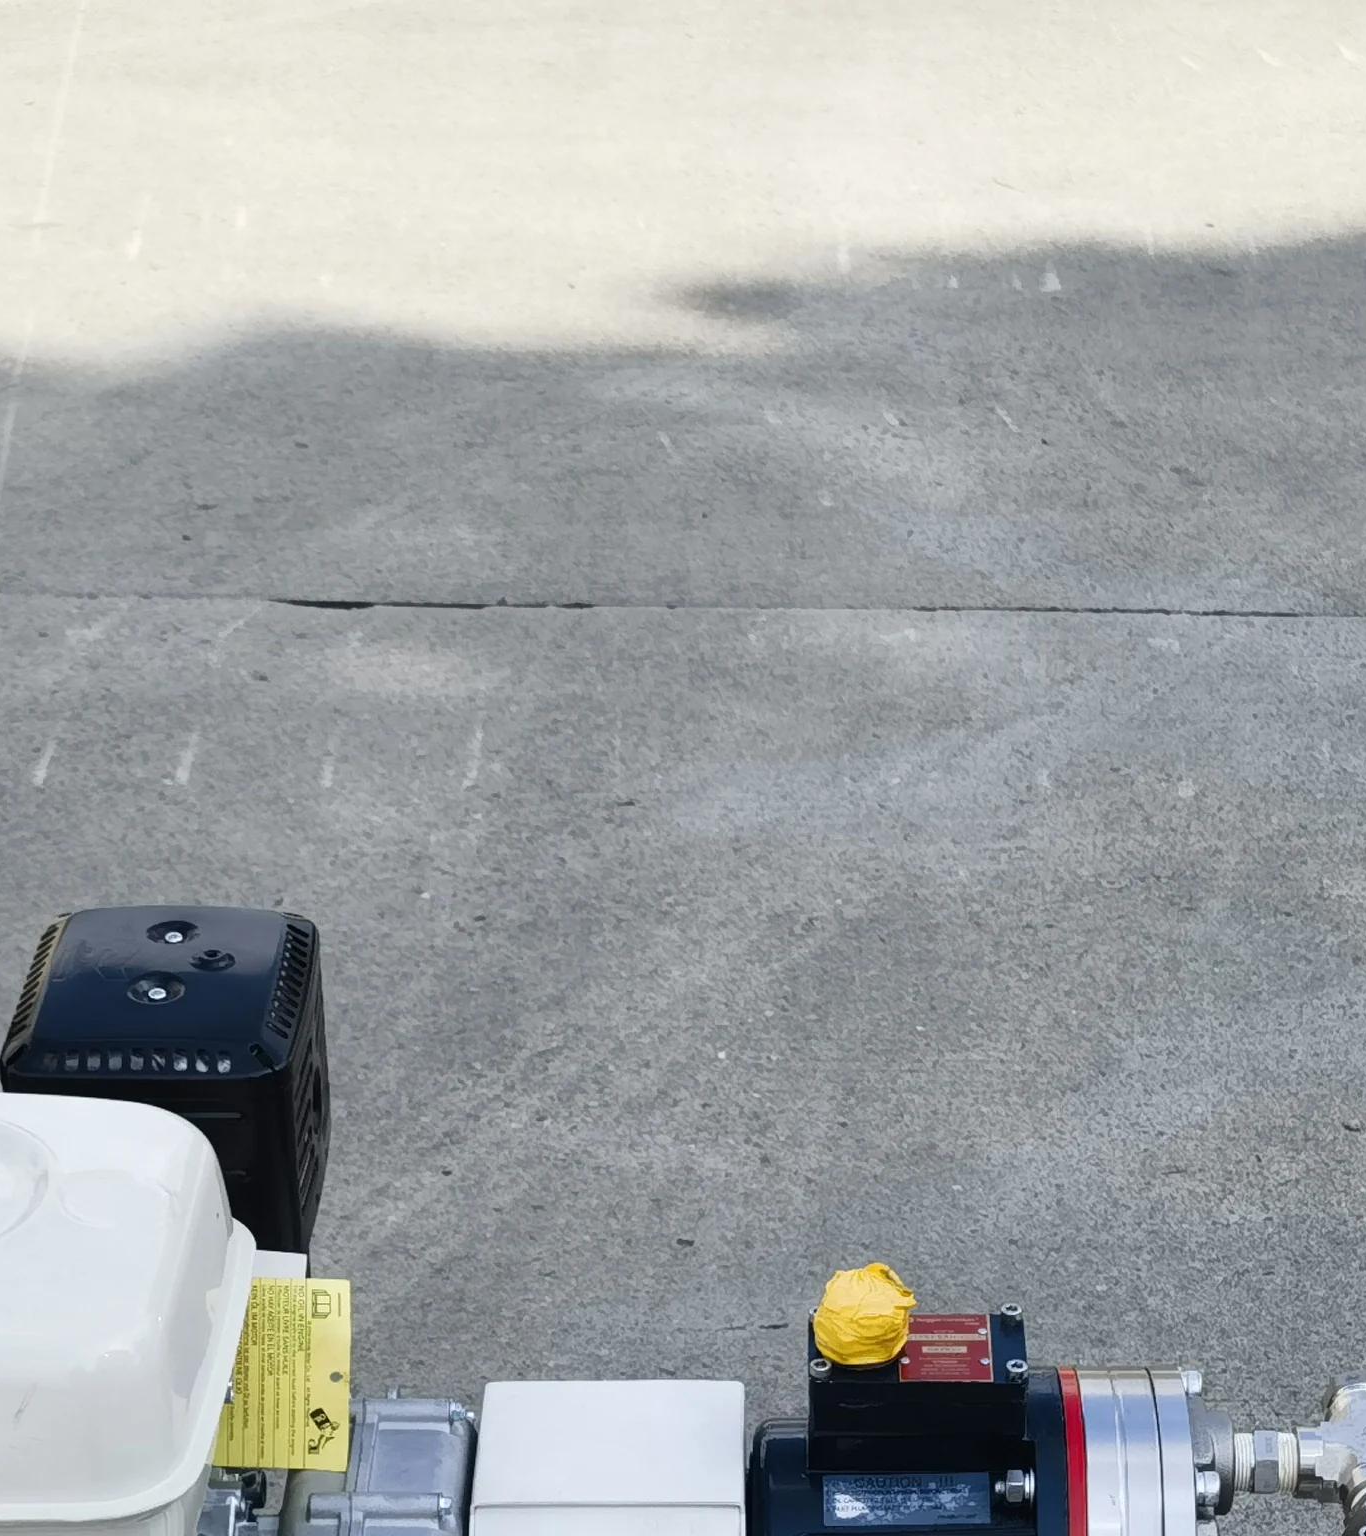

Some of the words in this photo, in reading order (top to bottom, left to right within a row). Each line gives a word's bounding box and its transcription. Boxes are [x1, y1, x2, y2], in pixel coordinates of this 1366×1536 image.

[267, 1285, 275, 1295] NO
[298, 1285, 304, 1297] NO
[267, 1297, 275, 1309] HAY
[251, 1312, 257, 1320] IM
[298, 1313, 304, 1322] IN
[267, 1334, 275, 1342] EN
[267, 1353, 275, 1376] MOTOR
[854, 1477, 921, 1488] CAUTION
